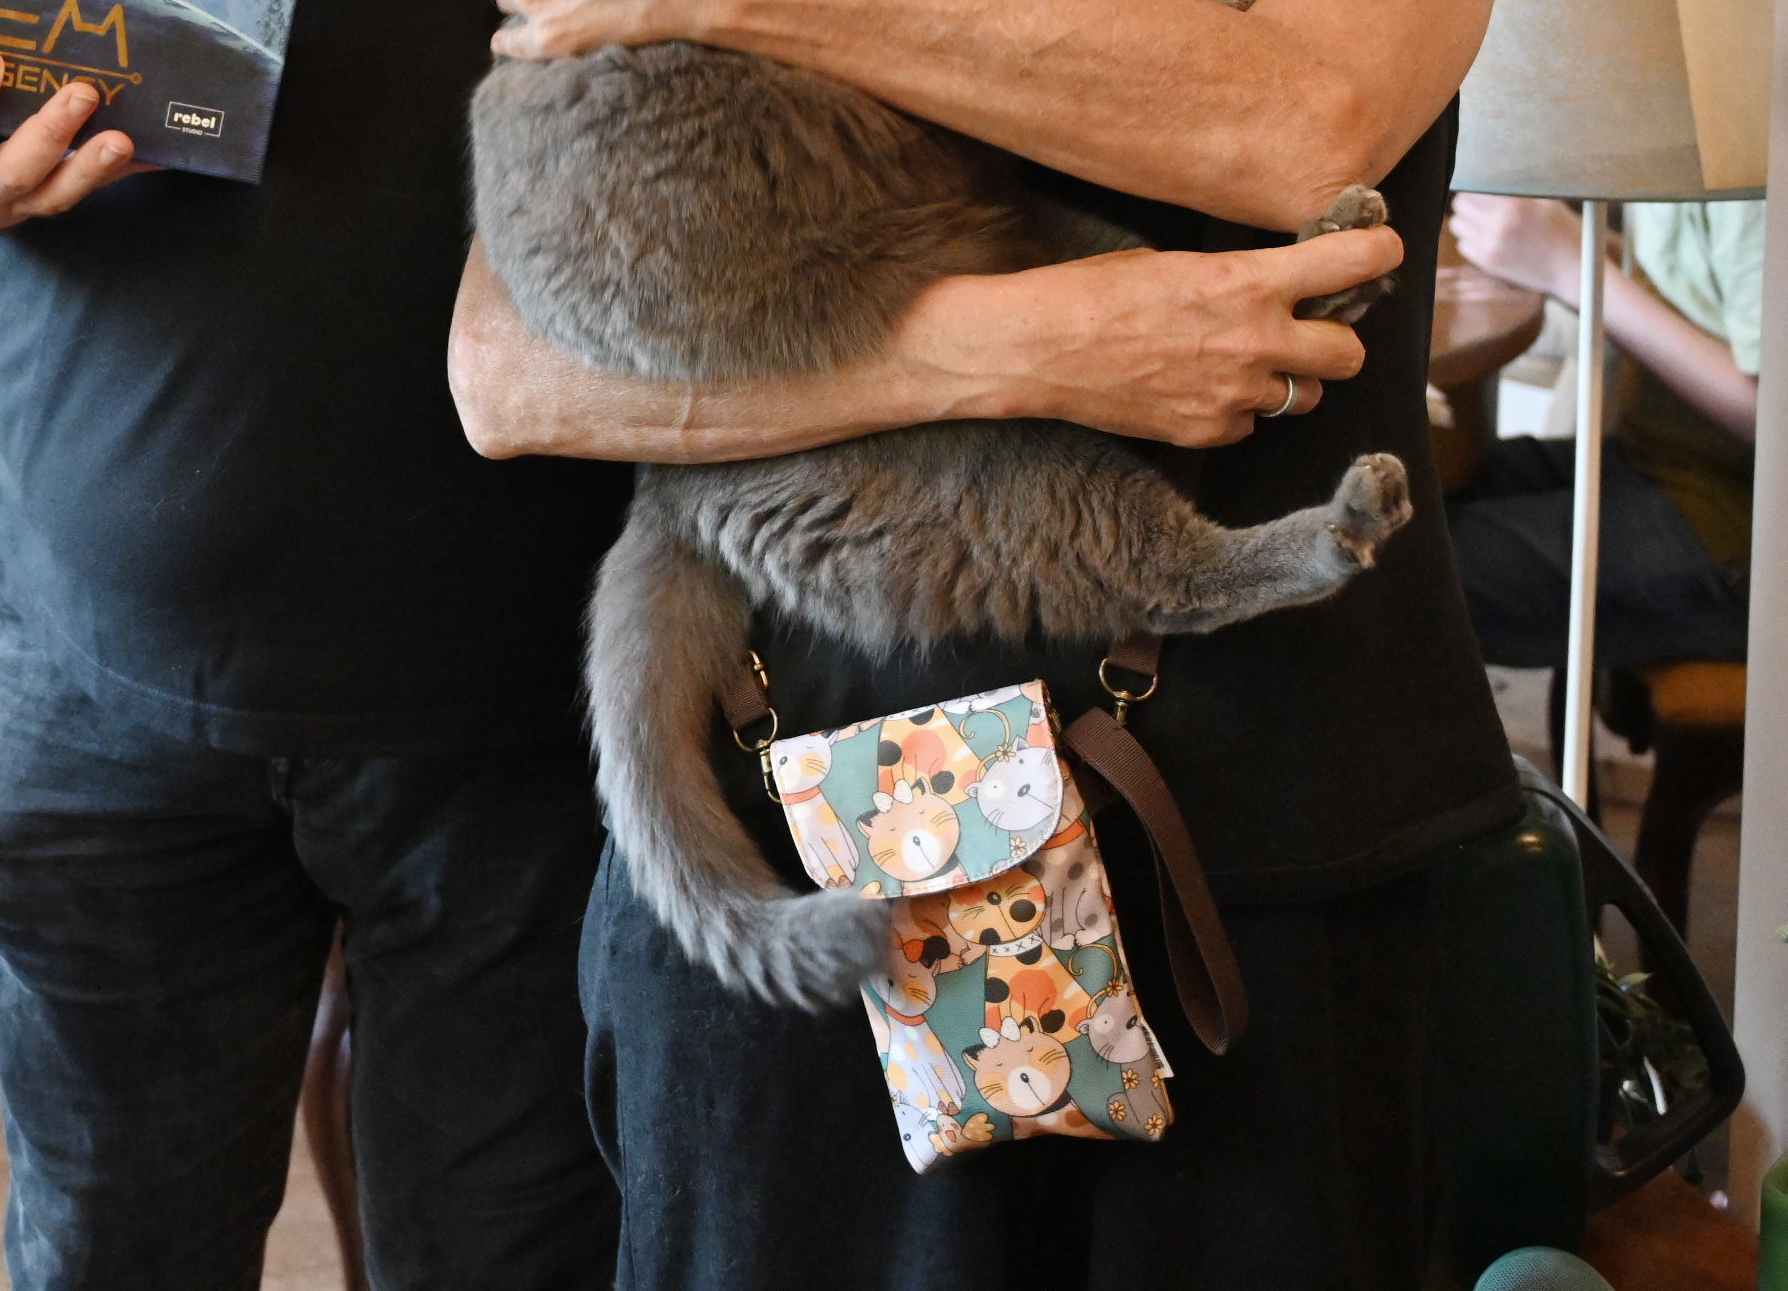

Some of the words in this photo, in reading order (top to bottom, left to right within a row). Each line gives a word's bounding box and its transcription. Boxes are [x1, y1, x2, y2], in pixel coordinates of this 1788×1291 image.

[0, 62, 126, 106] GENY
[173, 112, 216, 129] rebel
[181, 127, 203, 136] STUDIO
